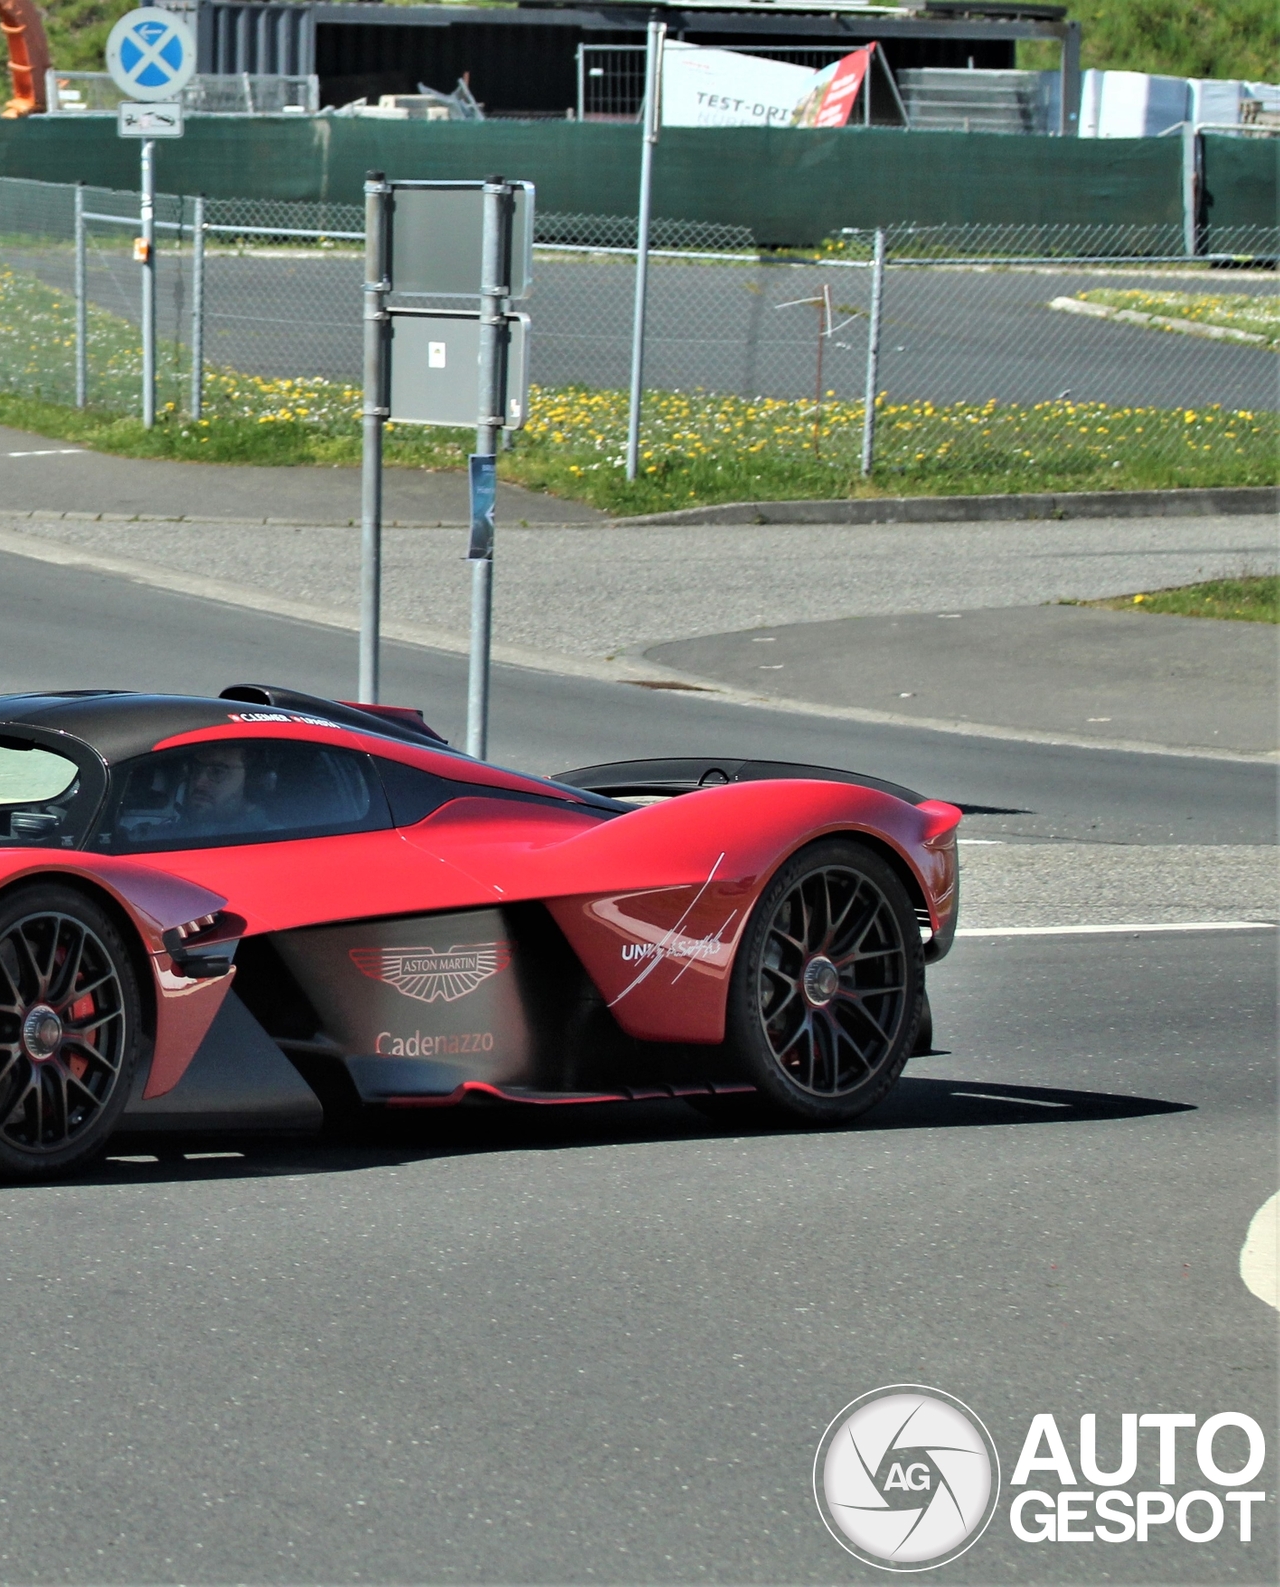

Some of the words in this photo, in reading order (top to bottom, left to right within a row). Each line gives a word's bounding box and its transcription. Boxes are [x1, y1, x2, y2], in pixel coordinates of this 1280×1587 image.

[697, 91, 792, 122] TEST-DRI
[403, 959, 438, 972] ASTON
[439, 957, 475, 970] MARTIN
[375, 1030, 494, 1057] Cadenazzo
